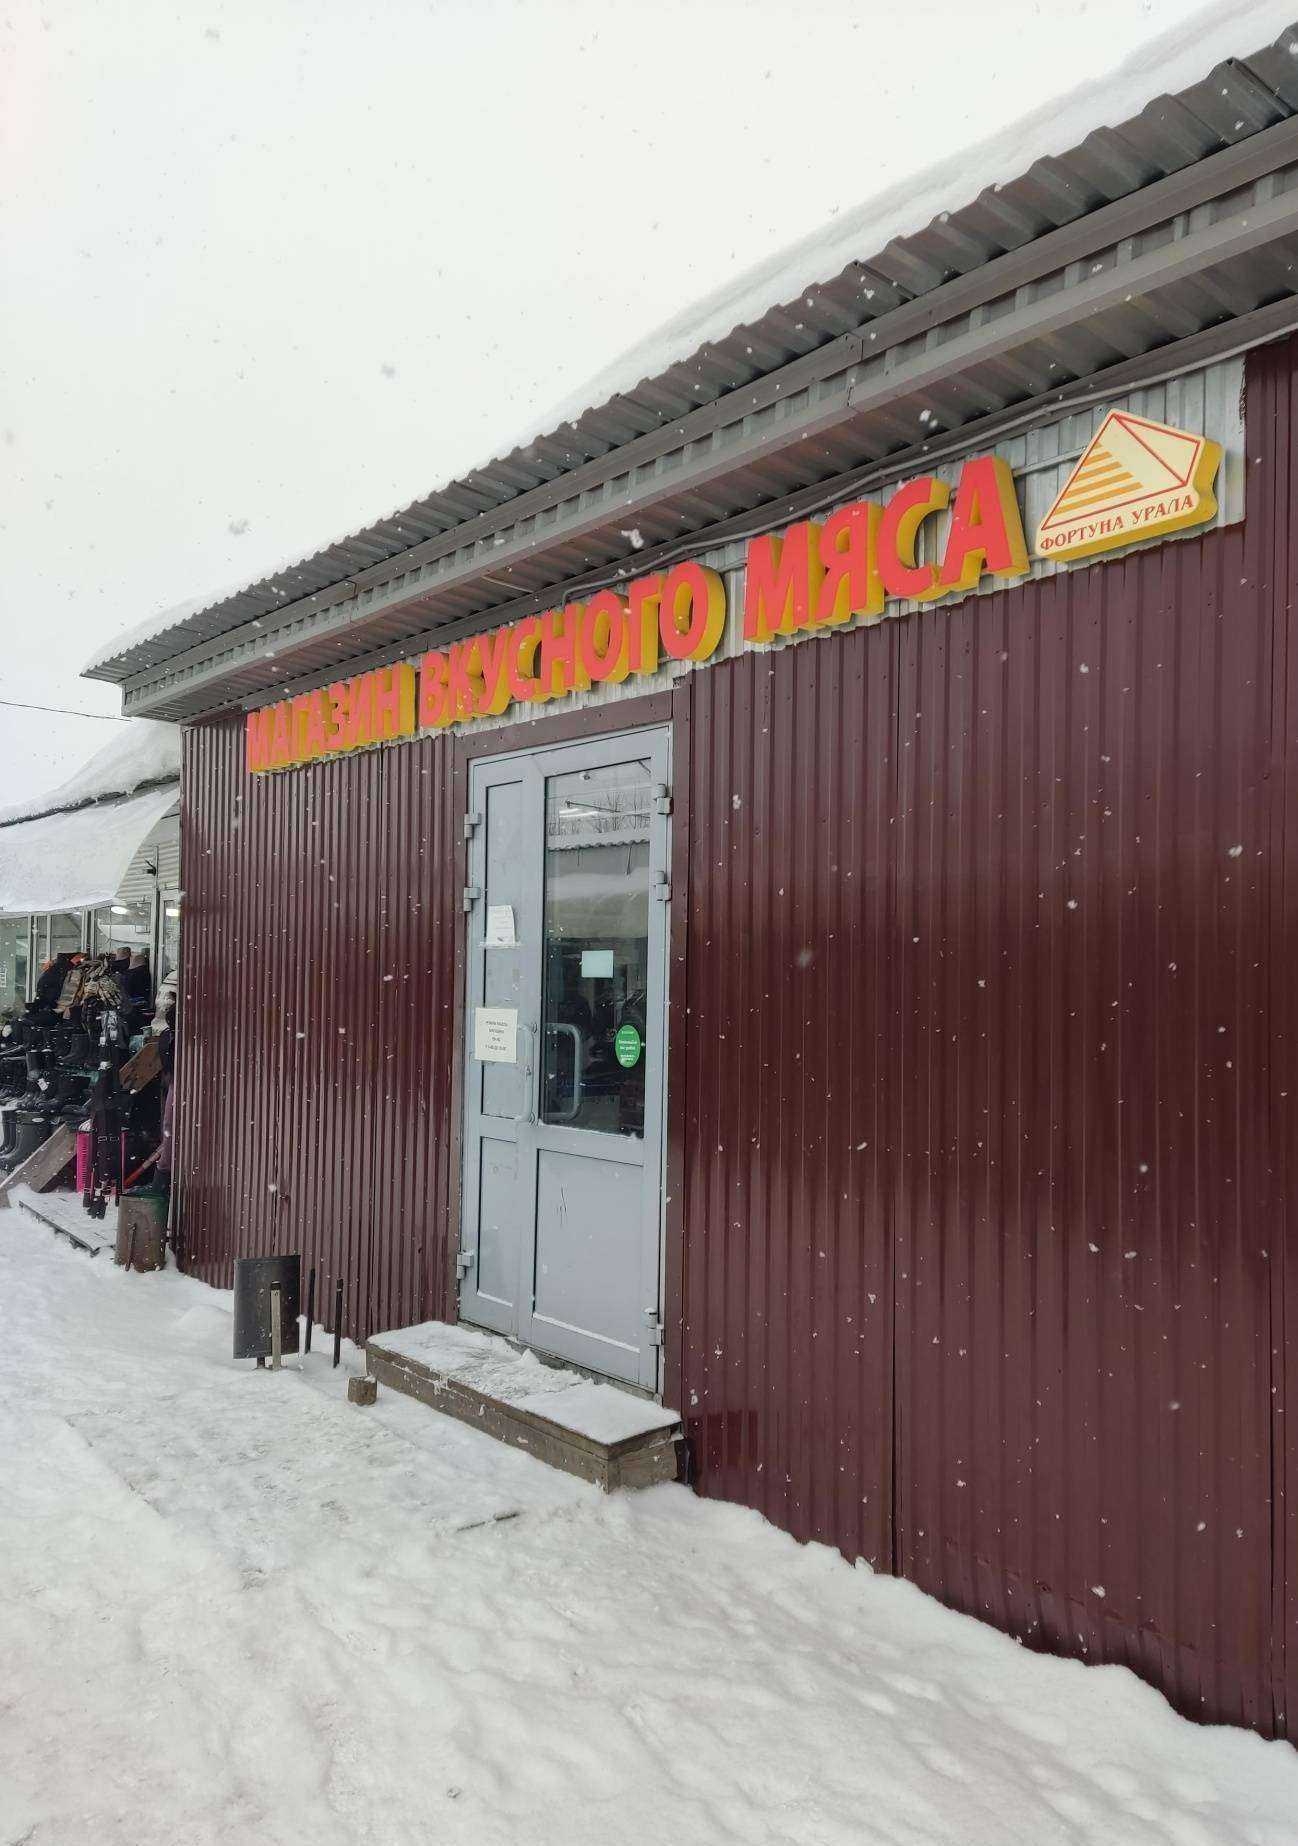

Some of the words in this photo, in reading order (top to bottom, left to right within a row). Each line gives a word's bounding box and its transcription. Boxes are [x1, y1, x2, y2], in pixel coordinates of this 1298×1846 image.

[246, 663, 415, 773] МАГАЗИН
[420, 562, 725, 728] ВКУСНОГО
[743, 455, 1029, 643] МЯСА
[1040, 516, 1124, 551] ФОРТУНА
[1131, 494, 1194, 525] УРАЛА
